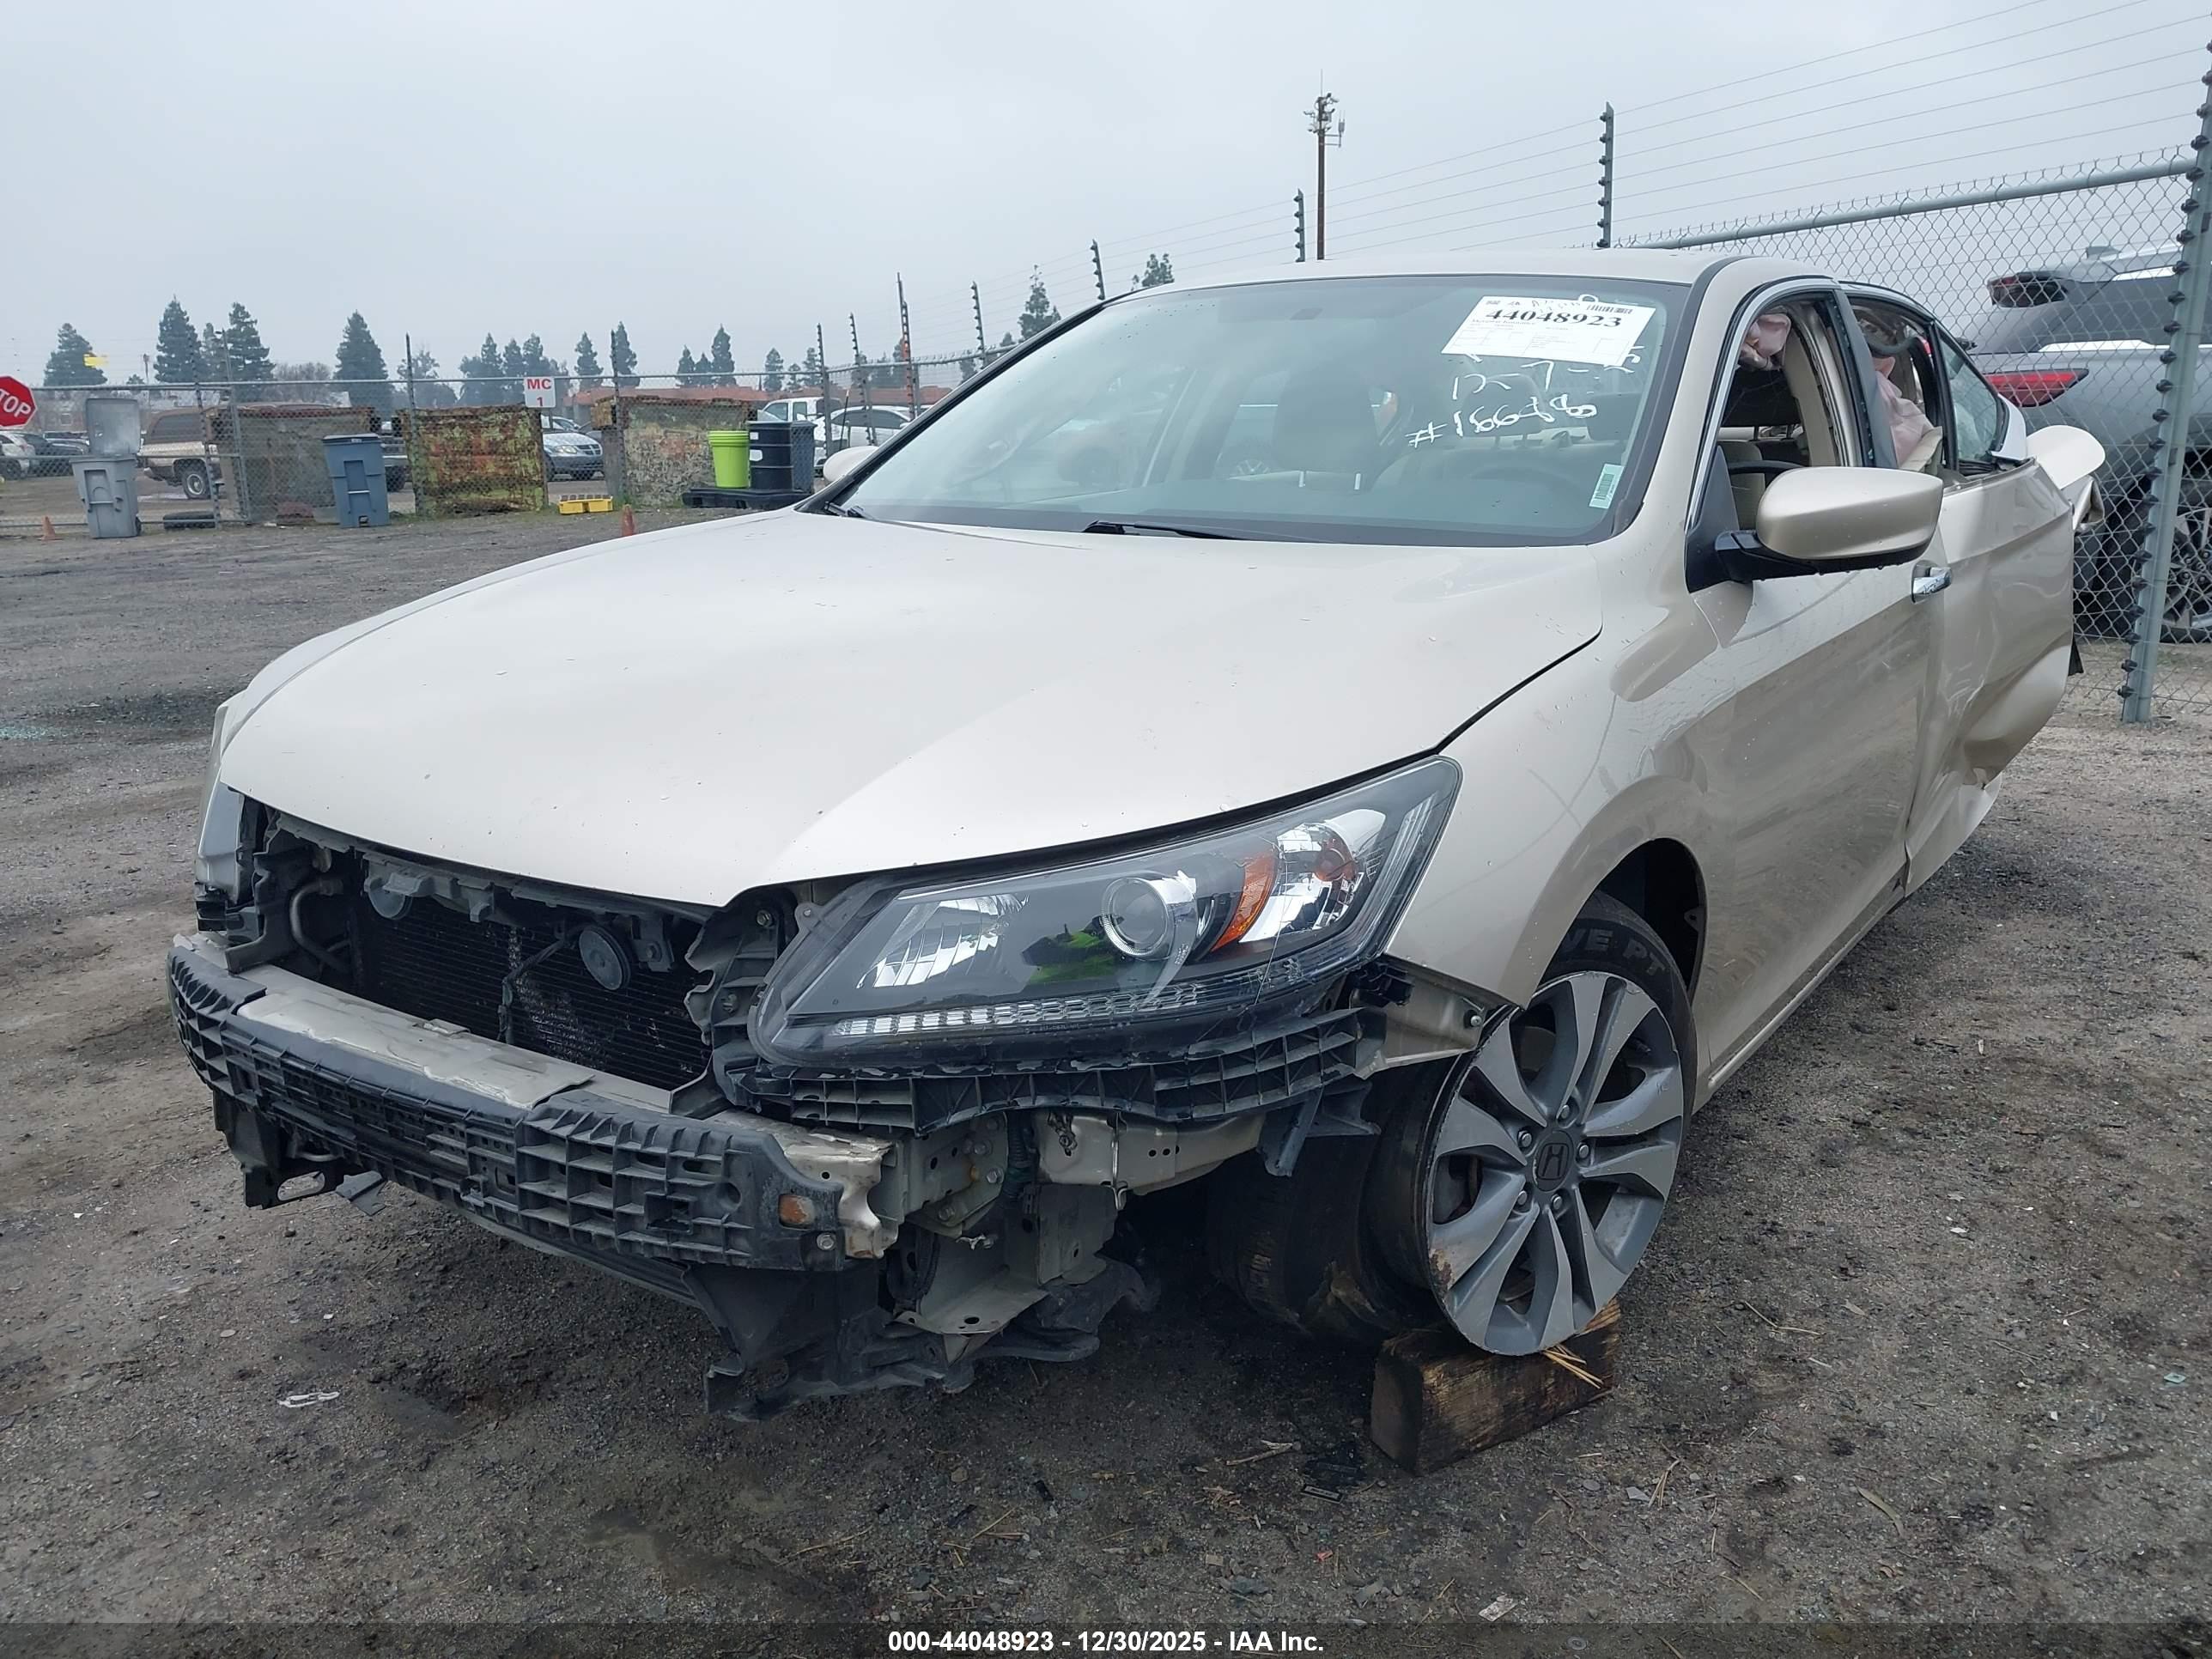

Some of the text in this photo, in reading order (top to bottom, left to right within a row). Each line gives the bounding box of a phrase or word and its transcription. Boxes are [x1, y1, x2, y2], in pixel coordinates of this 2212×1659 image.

[1486, 309, 1622, 328] 44048923
[526, 379, 552, 390] MC
[537, 397, 544, 407] 1
